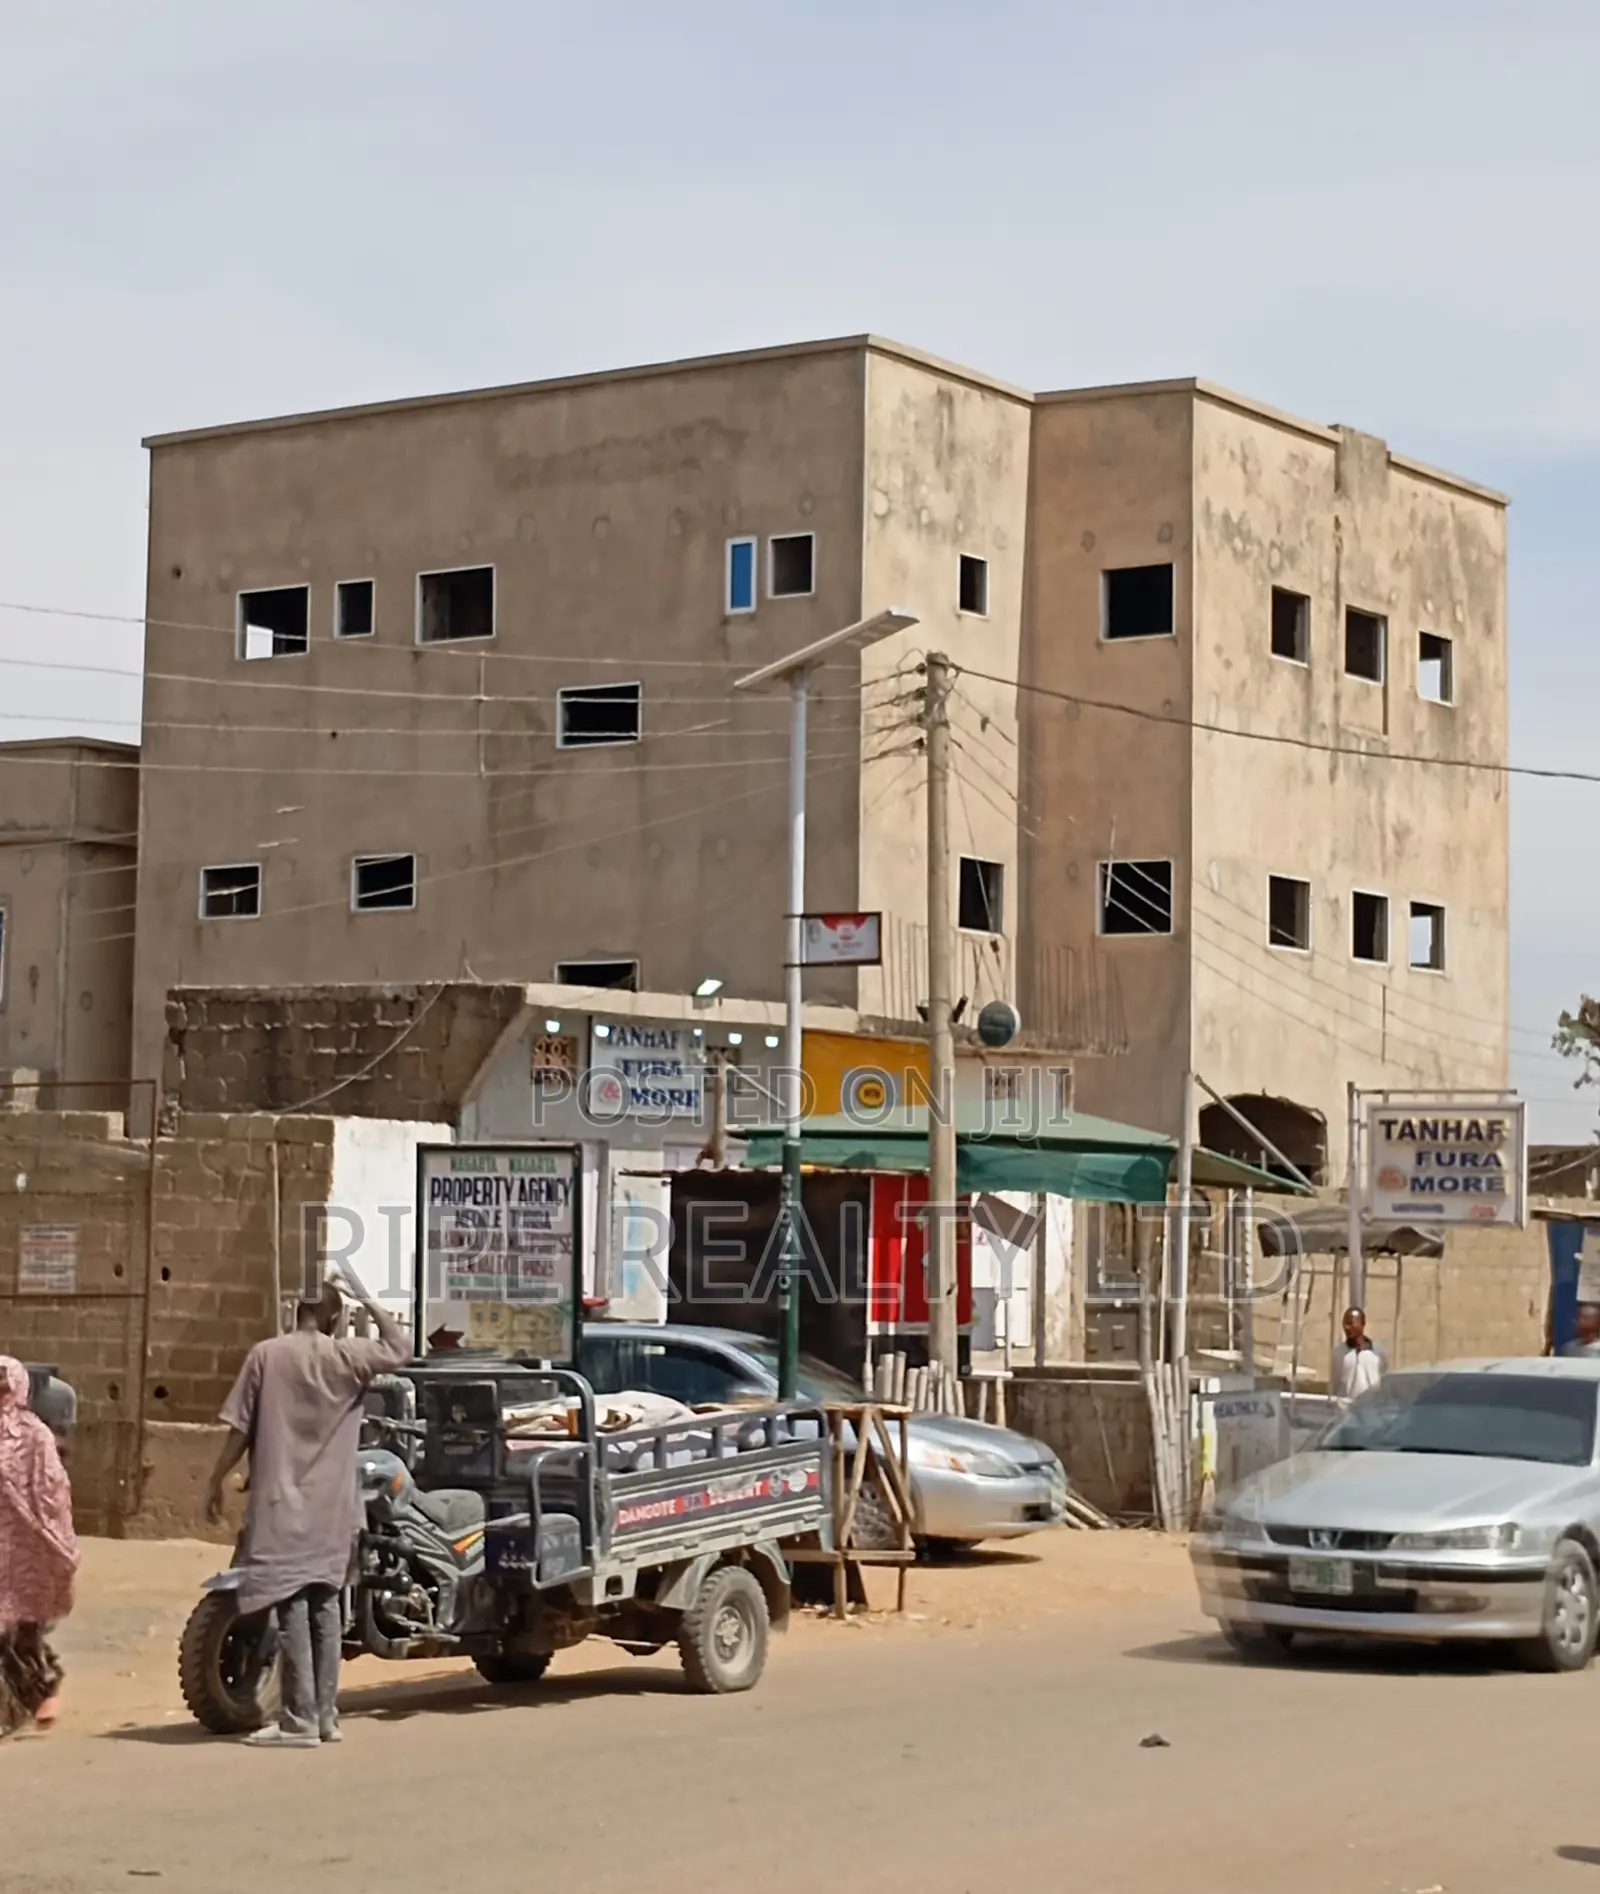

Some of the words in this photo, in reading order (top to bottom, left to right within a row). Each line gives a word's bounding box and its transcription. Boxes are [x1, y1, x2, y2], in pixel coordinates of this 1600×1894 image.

[630, 1087, 700, 1108] MORE
[1378, 1118, 1506, 1143] TANHAF
[1415, 1151, 1503, 1168] FURA
[431, 1176, 515, 1206] PROPERTY
[518, 1176, 574, 1207] AGENCY
[1410, 1175, 1505, 1193] MORE
[618, 1498, 677, 1524] DANGOTE
